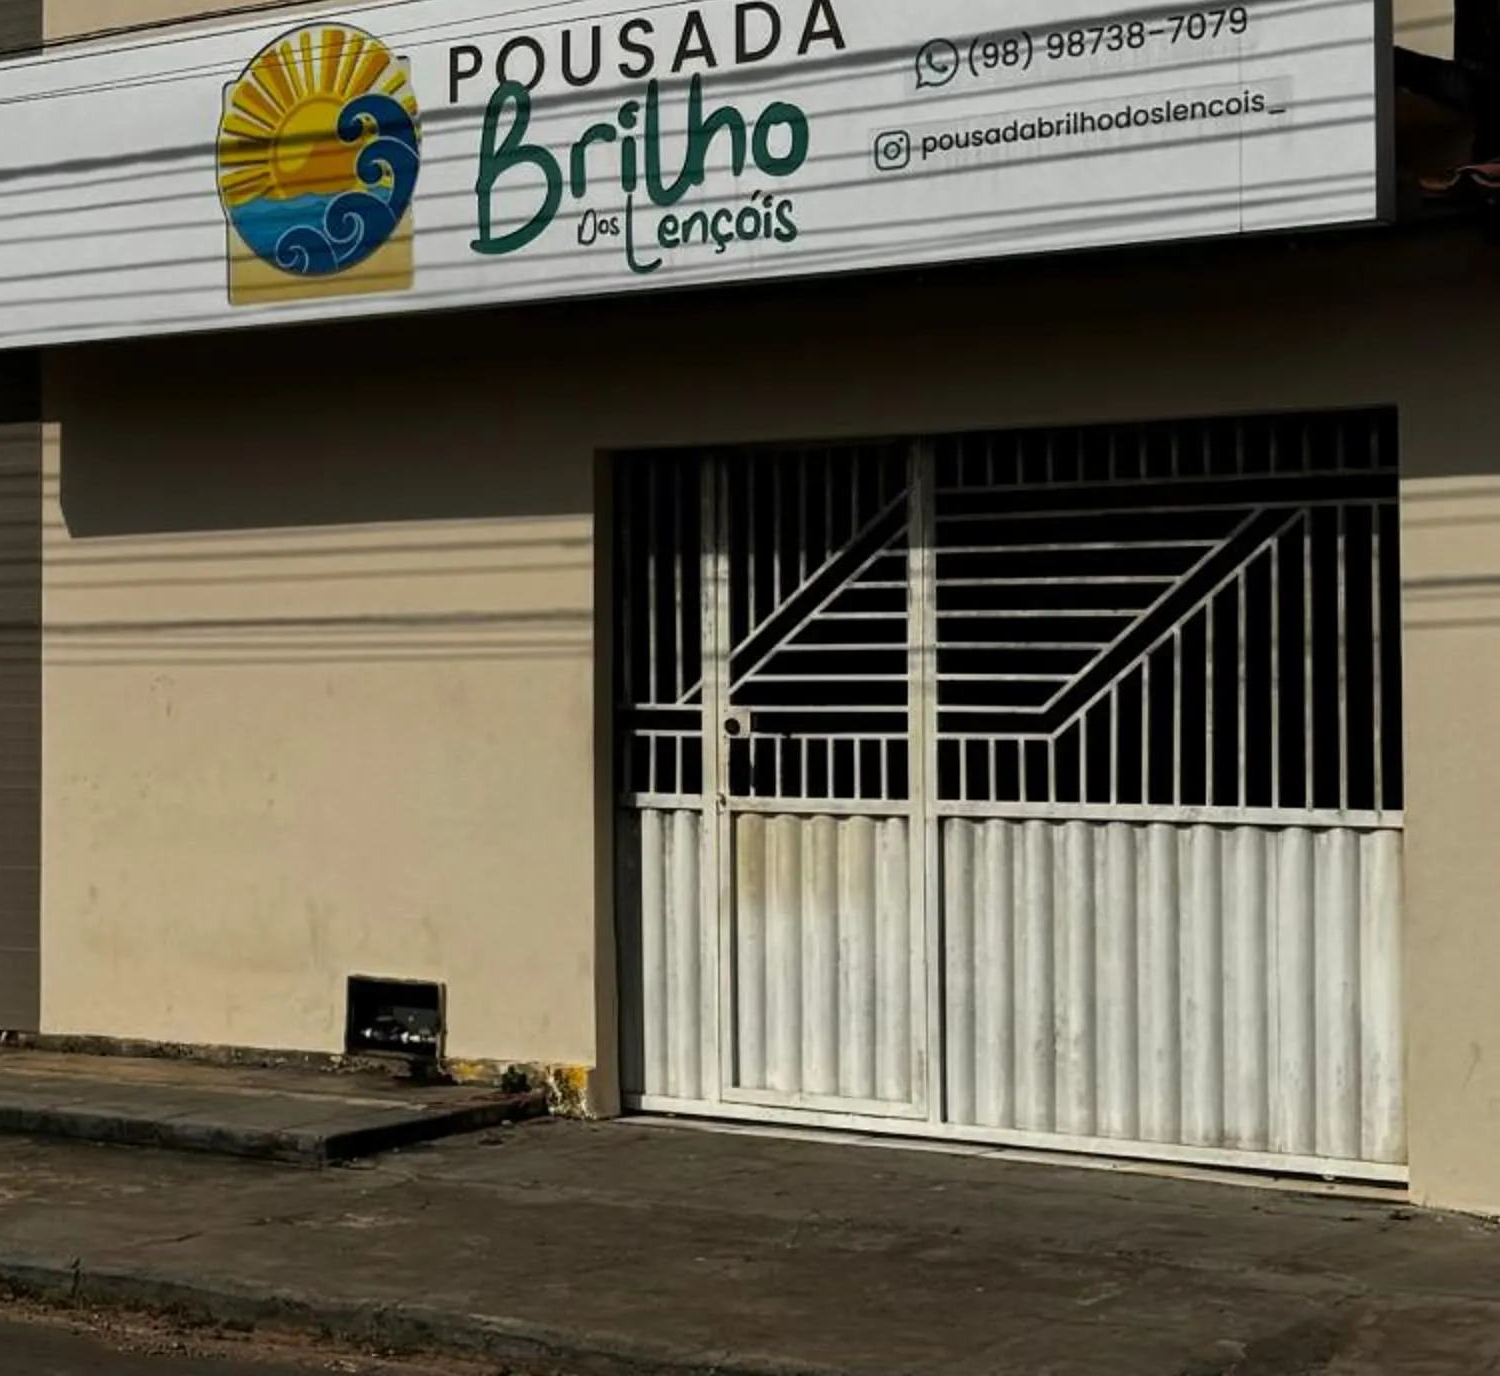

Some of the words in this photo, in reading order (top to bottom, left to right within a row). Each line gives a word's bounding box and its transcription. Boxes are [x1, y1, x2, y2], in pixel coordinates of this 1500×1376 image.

[967, 30, 1034, 77] (98)
[1046, 6, 1248, 60] 98738-7079
[921, 89, 1287, 160] pousadabrilhodoslencois_
[470, 72, 810, 256] Brilho
